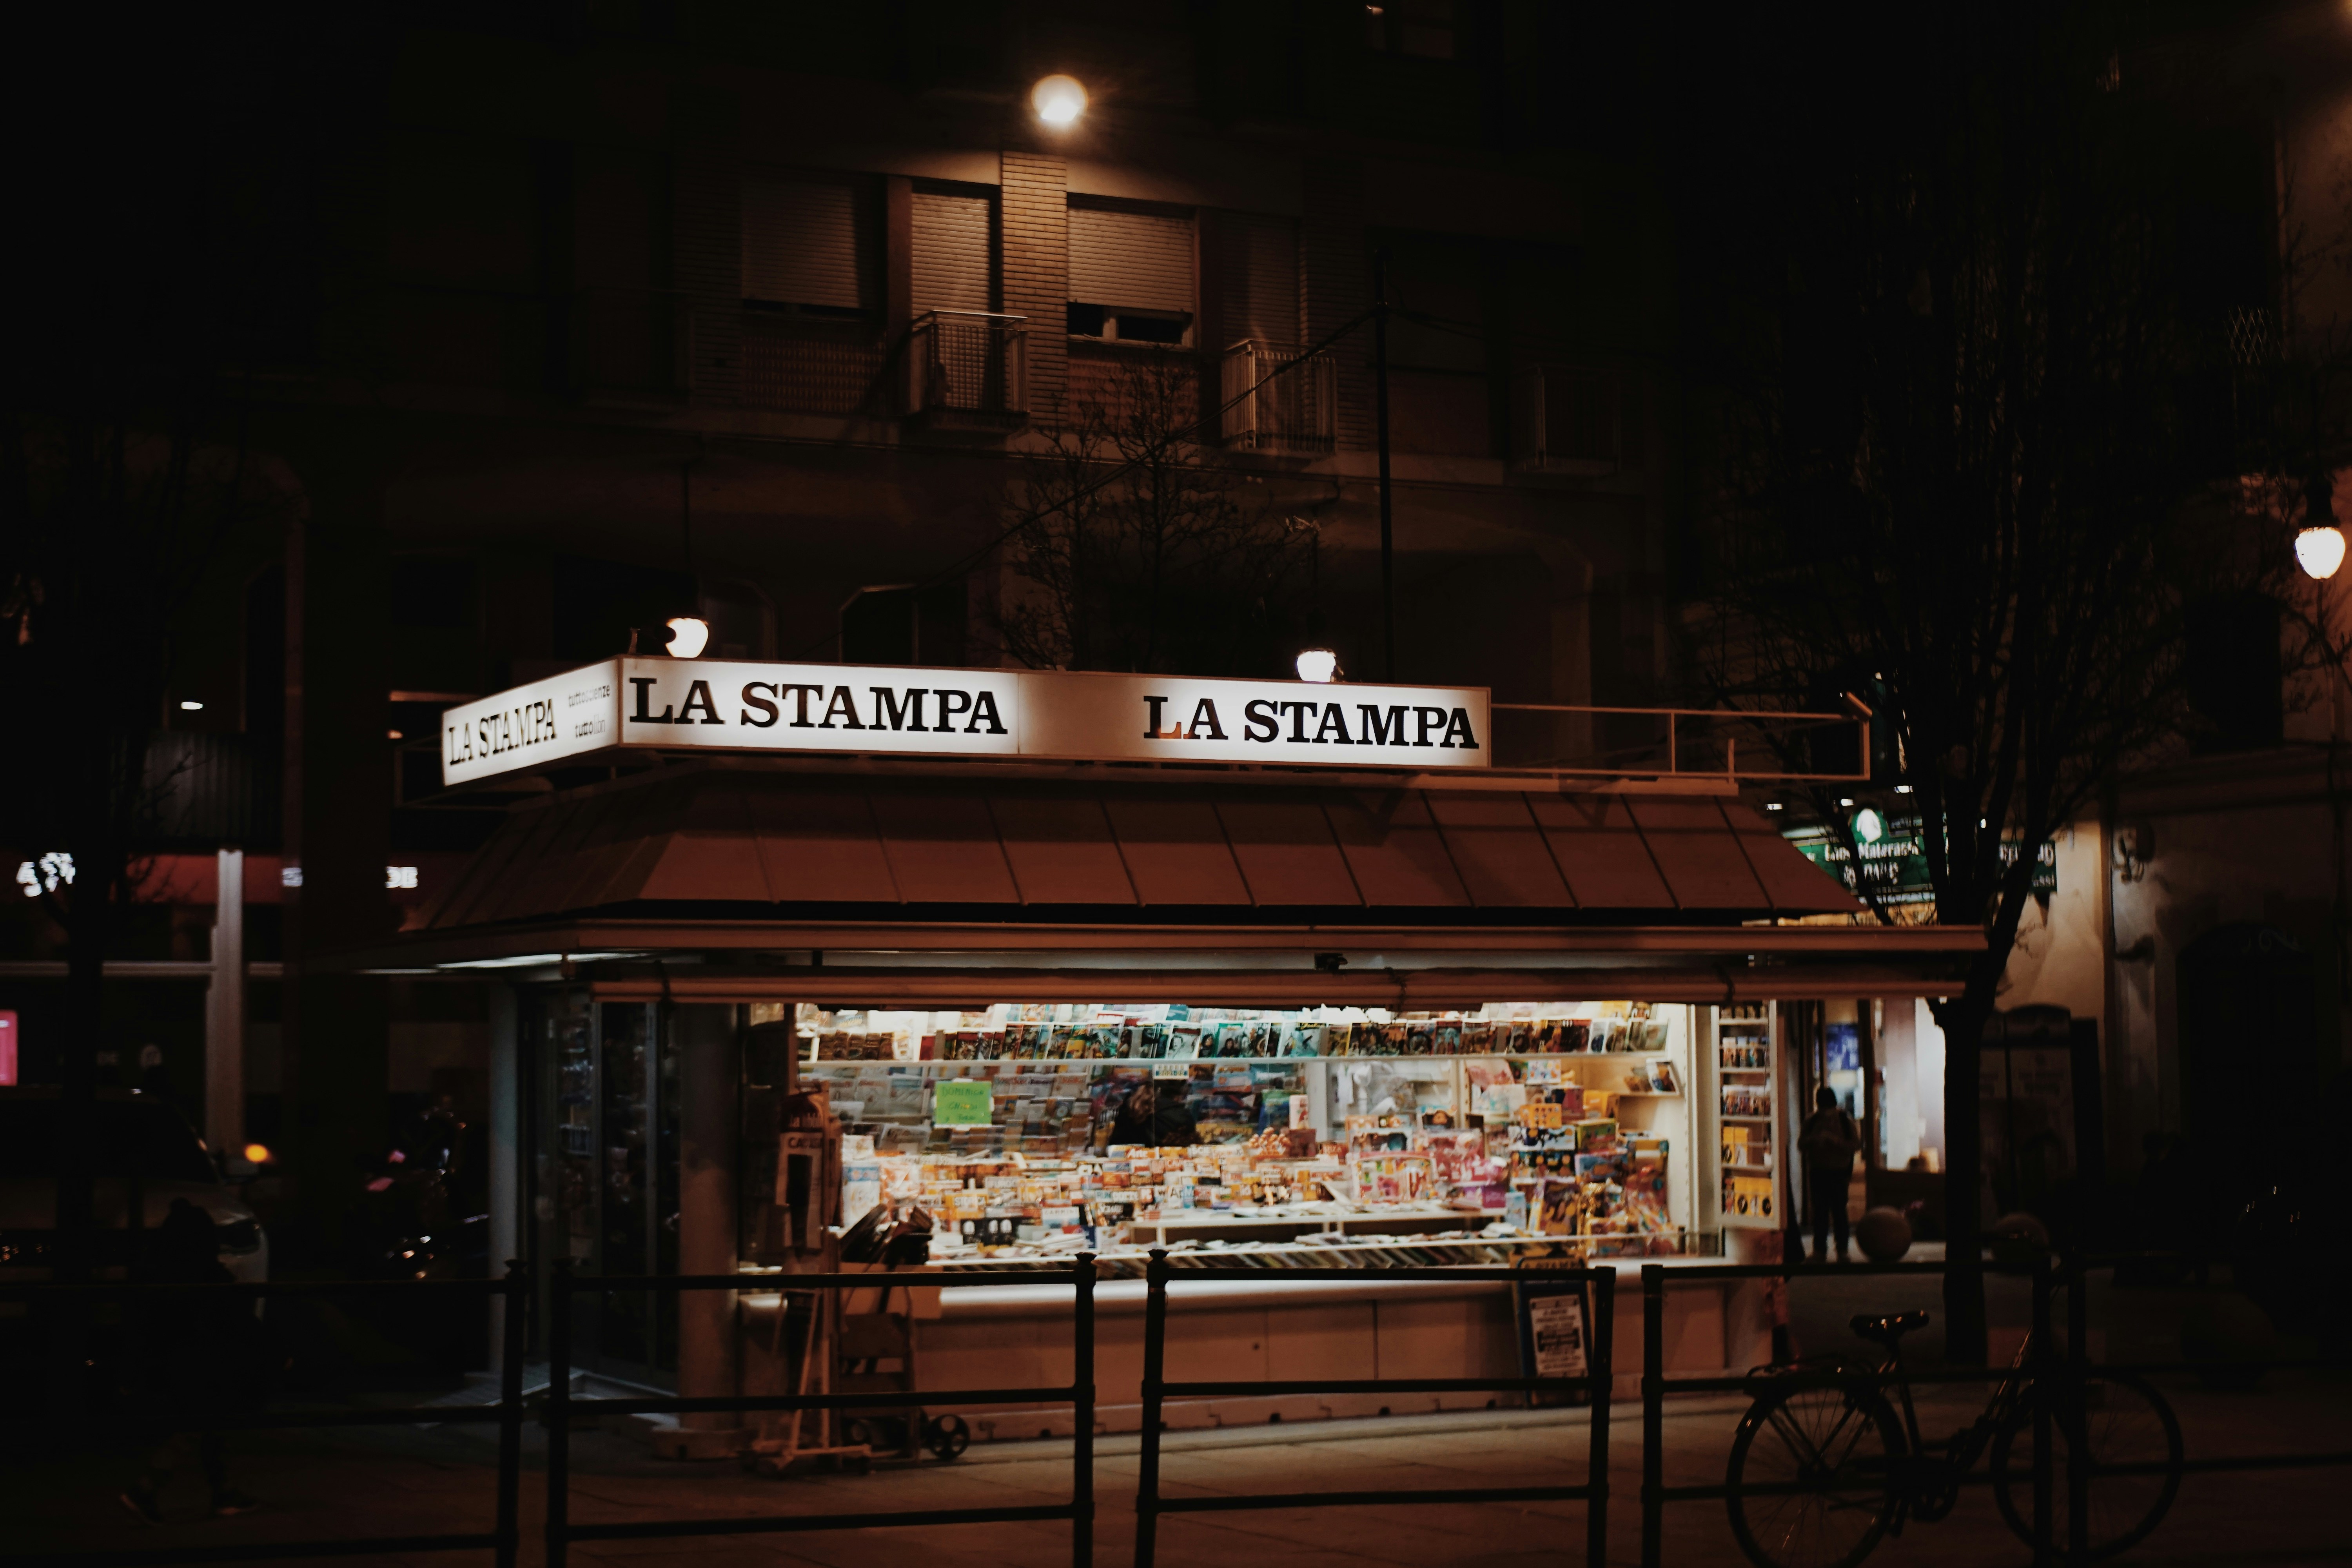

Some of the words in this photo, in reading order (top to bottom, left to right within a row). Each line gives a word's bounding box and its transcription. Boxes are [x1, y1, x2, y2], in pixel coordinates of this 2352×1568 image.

[568, 684, 610, 708] tuttoscienze
[629, 677, 724, 725] LA
[741, 681, 1008, 734] STAMPA
[1143, 696, 1228, 740] LA
[1244, 699, 1479, 748] STAMPA
[449, 722, 474, 766] LA
[479, 698, 557, 759] STAMPA
[575, 712, 606, 739] tuttolibri
